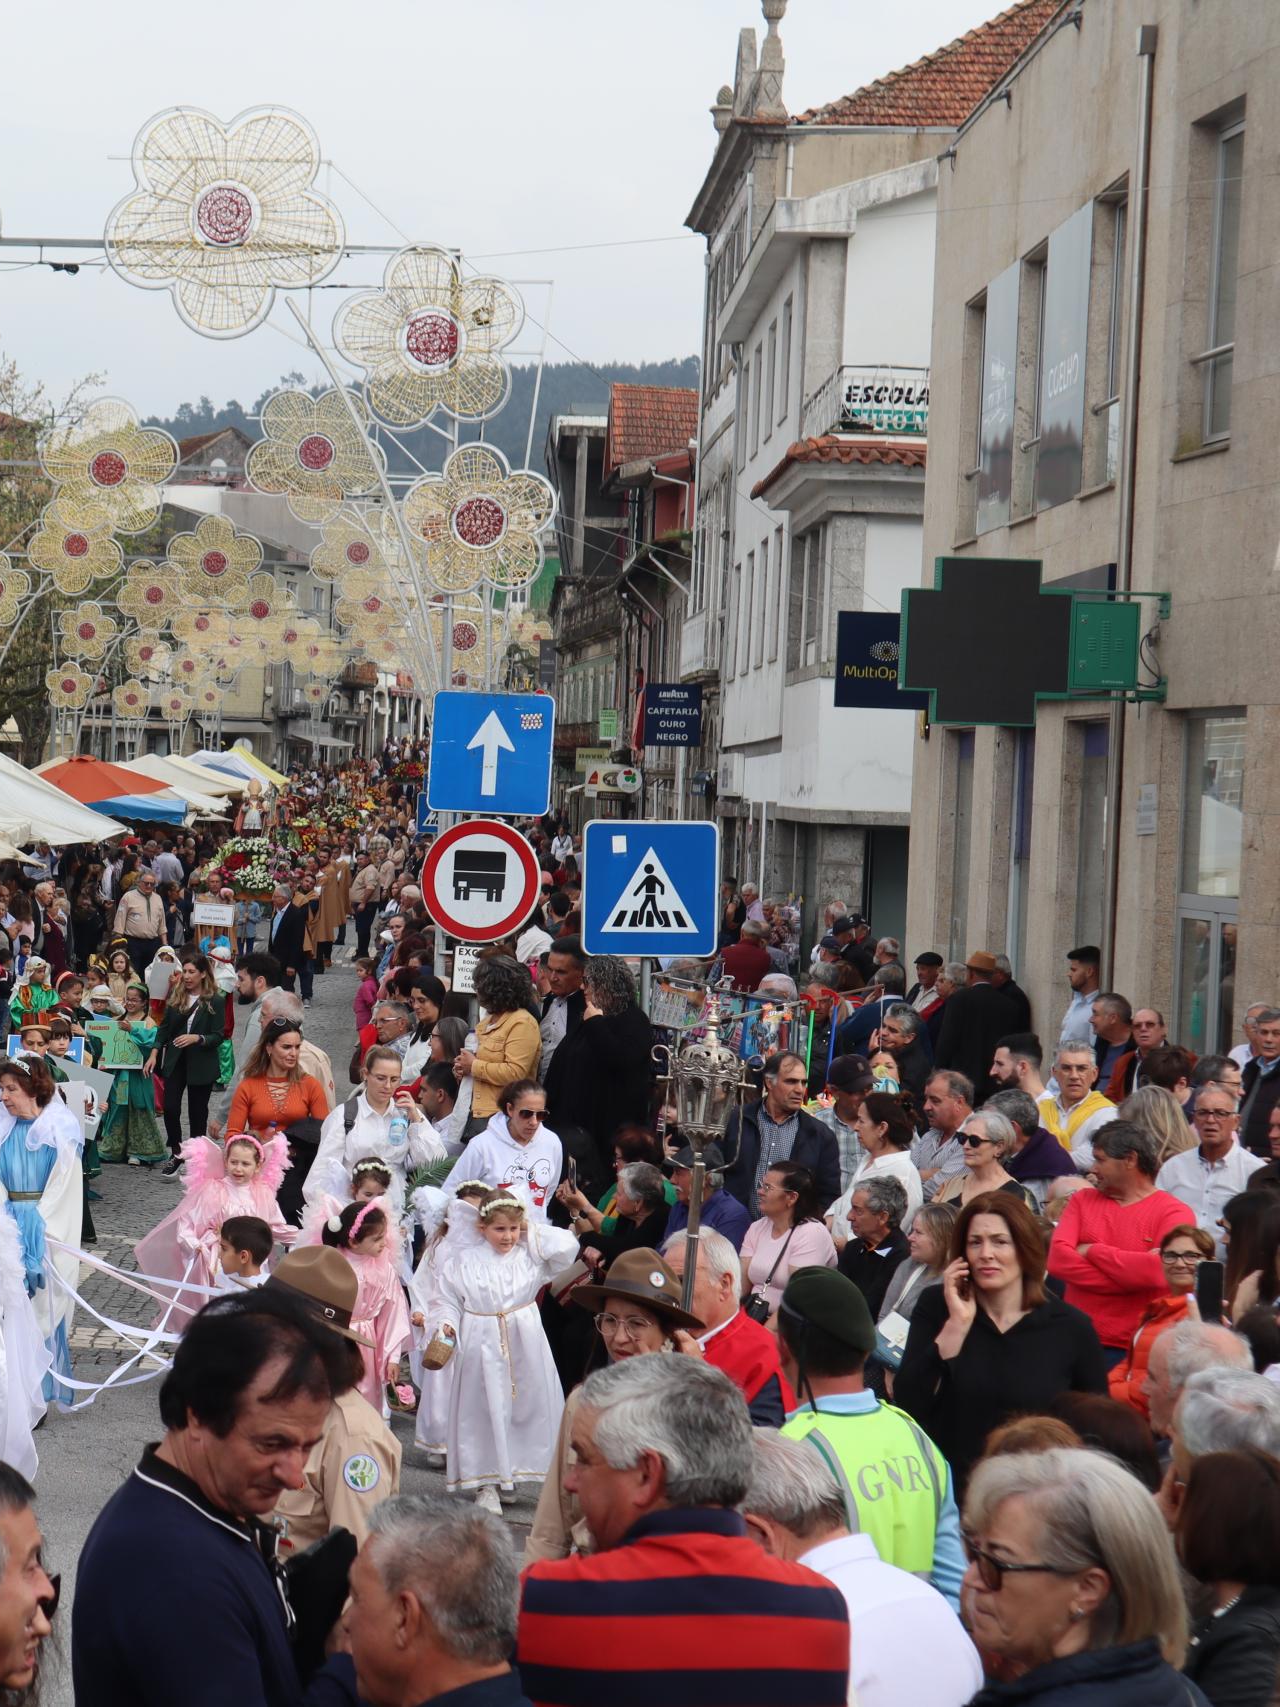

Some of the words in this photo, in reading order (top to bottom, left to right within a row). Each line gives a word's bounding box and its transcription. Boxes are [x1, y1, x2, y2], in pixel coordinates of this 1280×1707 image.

[845, 385, 929, 405] ESCOLA
[843, 664, 897, 681] MultiOp
[647, 707, 699, 716] CAFETARIA
[659, 720, 686, 728] OURO
[656, 733, 689, 741] NEGRO
[857, 1455, 931, 1502] GNR
